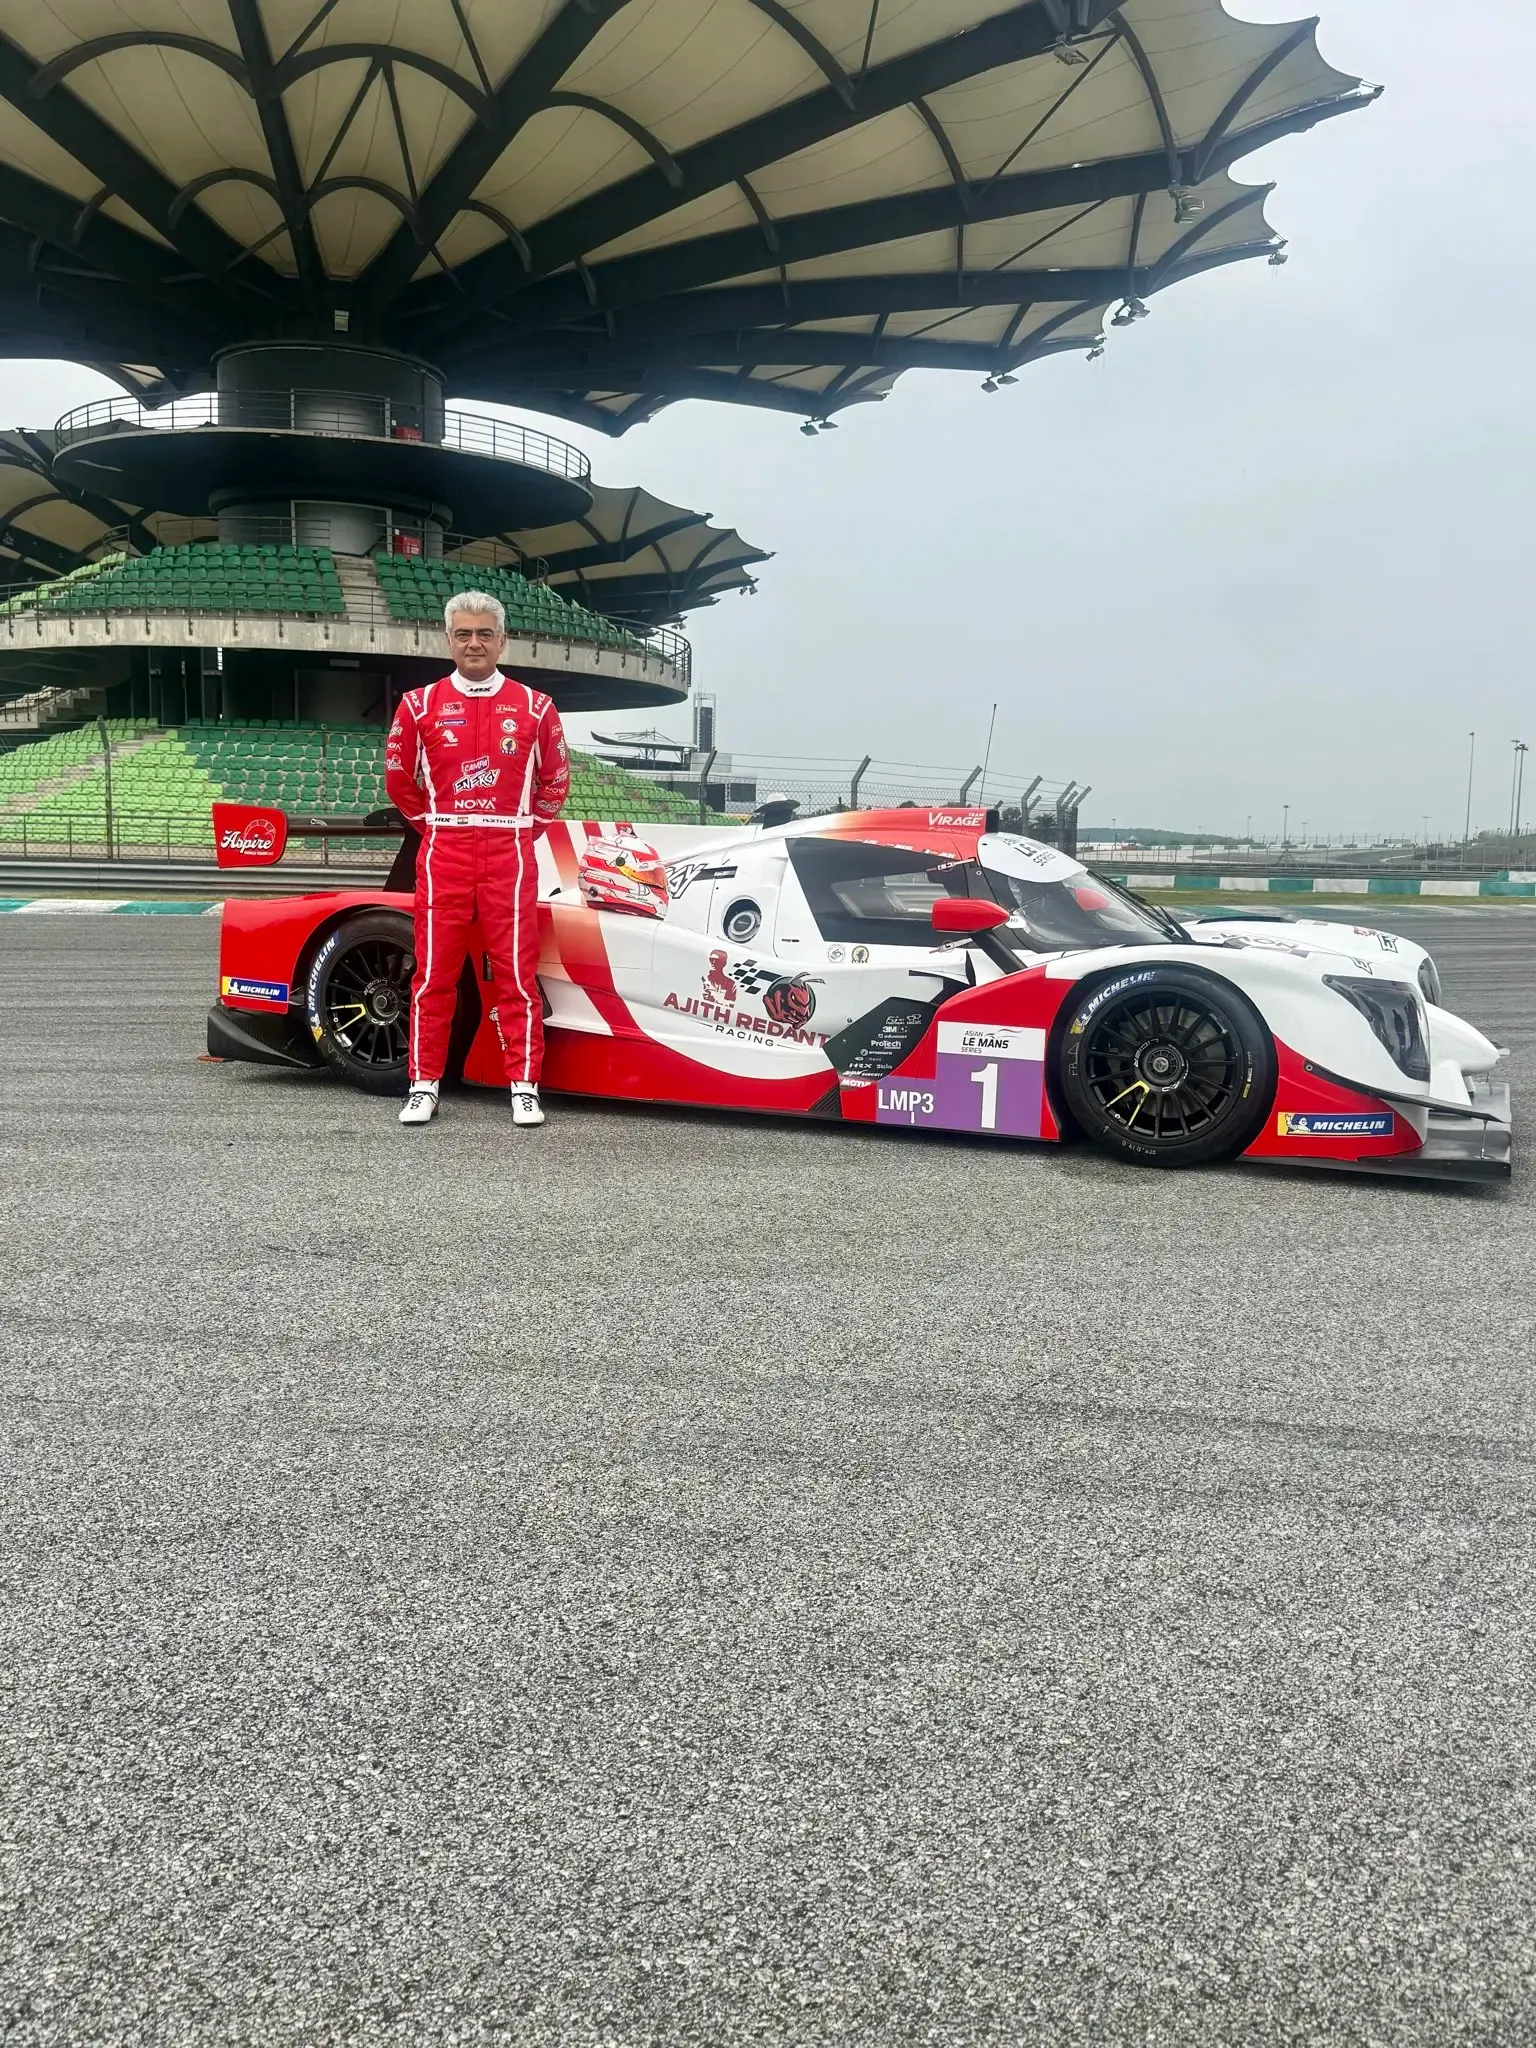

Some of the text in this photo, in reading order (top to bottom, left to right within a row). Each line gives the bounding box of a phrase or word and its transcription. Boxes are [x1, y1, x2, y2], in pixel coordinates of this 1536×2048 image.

[464, 758, 488, 771] CAMPA
[454, 769, 500, 794] ENERGY
[454, 799, 496, 809] NOVA
[928, 812, 983, 827] VIRAGE
[221, 830, 272, 854] Aspire
[308, 937, 335, 1011] MICHELIN
[240, 985, 280, 996] MICHELIN
[1087, 970, 1157, 1012] MICHELIN
[663, 992, 731, 1024] AJITH
[715, 1025, 774, 1047] RACING
[735, 1012, 831, 1048] REDANT
[882, 1025, 897, 1033] 3M
[963, 1037, 1009, 1049] LE MANS
[878, 1089, 934, 1113] LMP3
[971, 1063, 998, 1128] 1
[1312, 1120, 1386, 1130] MICHELIN
